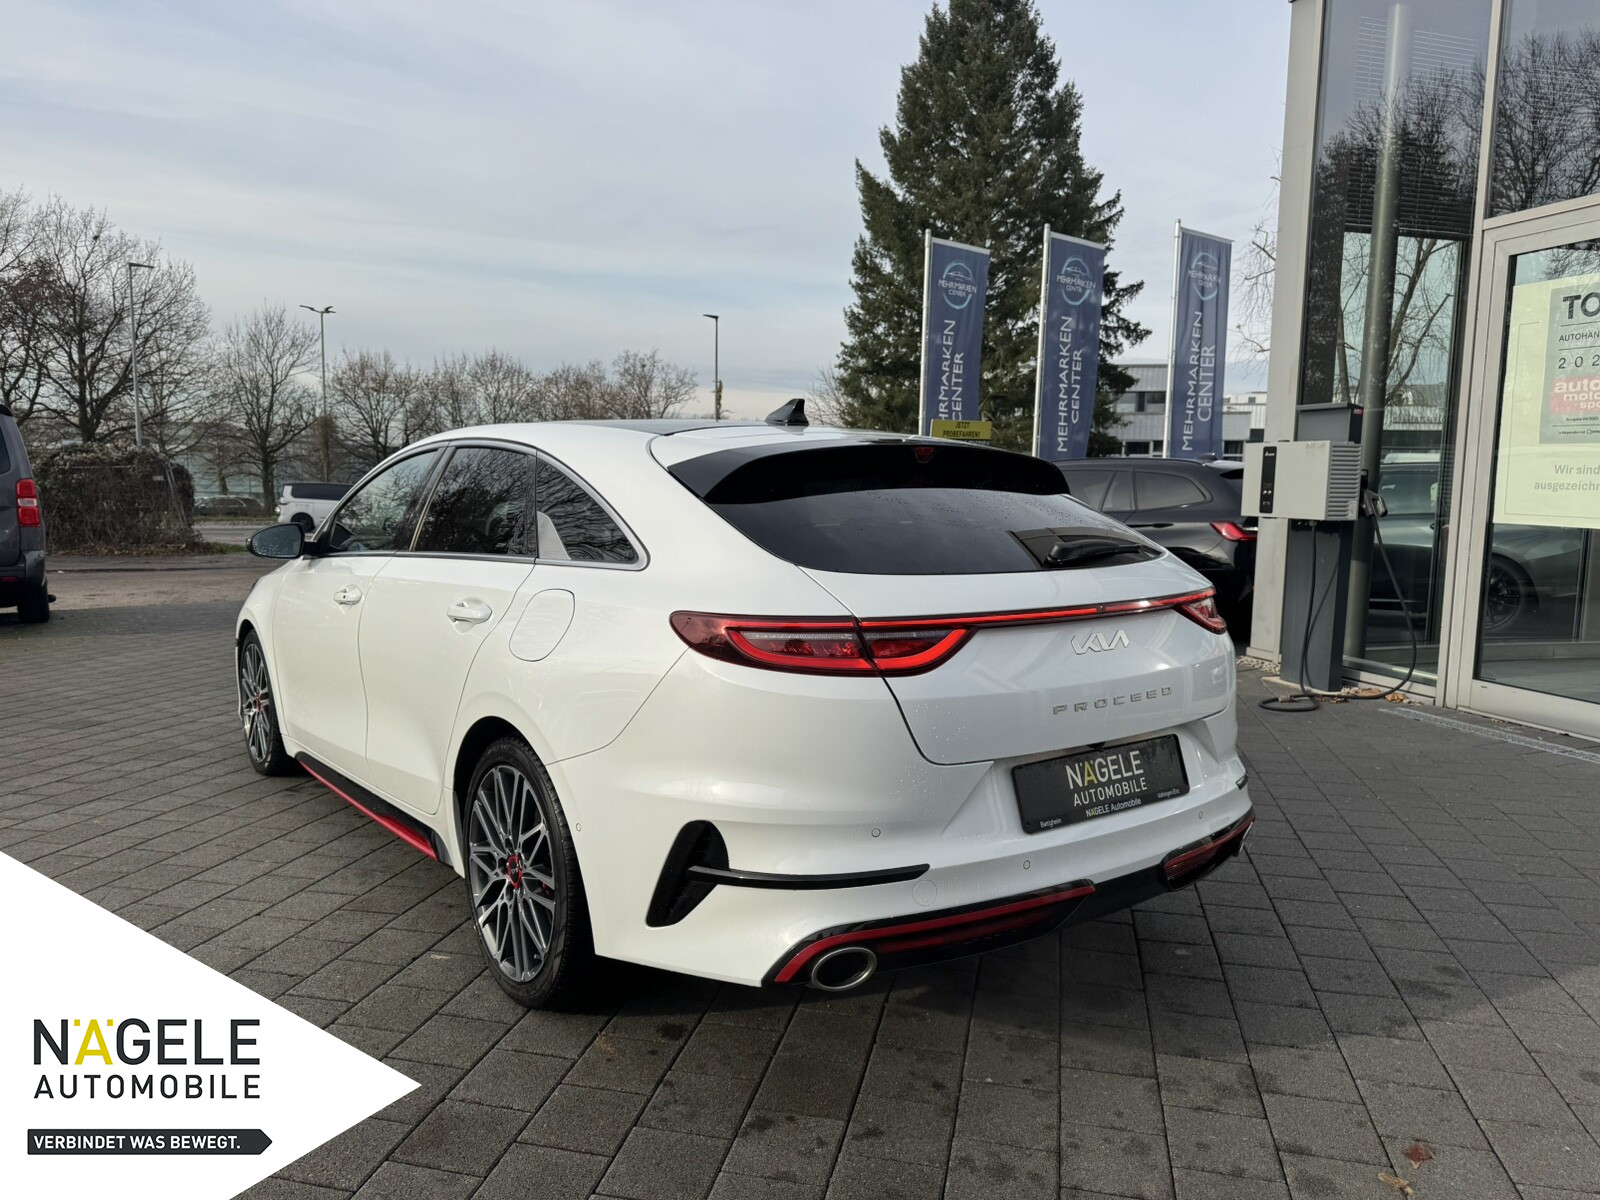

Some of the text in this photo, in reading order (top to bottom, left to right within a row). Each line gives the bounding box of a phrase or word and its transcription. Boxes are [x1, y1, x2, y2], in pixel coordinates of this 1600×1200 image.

[1562, 291, 1600, 319] TO
[950, 352, 964, 421] CENTER
[1057, 316, 1073, 452] MEHRMARKEN
[1071, 349, 1083, 424] CENTER
[1182, 311, 1203, 451] MEHRMARKEN
[1197, 344, 1216, 422] CENTER
[1554, 379, 1600, 393] auto
[955, 421, 970, 429] JETZT
[1554, 464, 1600, 475] Wir sind
[1071, 629, 1130, 655] KIA
[1053, 687, 1172, 715] PROCEED
[1065, 750, 1144, 790] NÄGELE
[1074, 777, 1148, 807] AUTOMOBILE
[1110, 798, 1142, 812] Automobile
